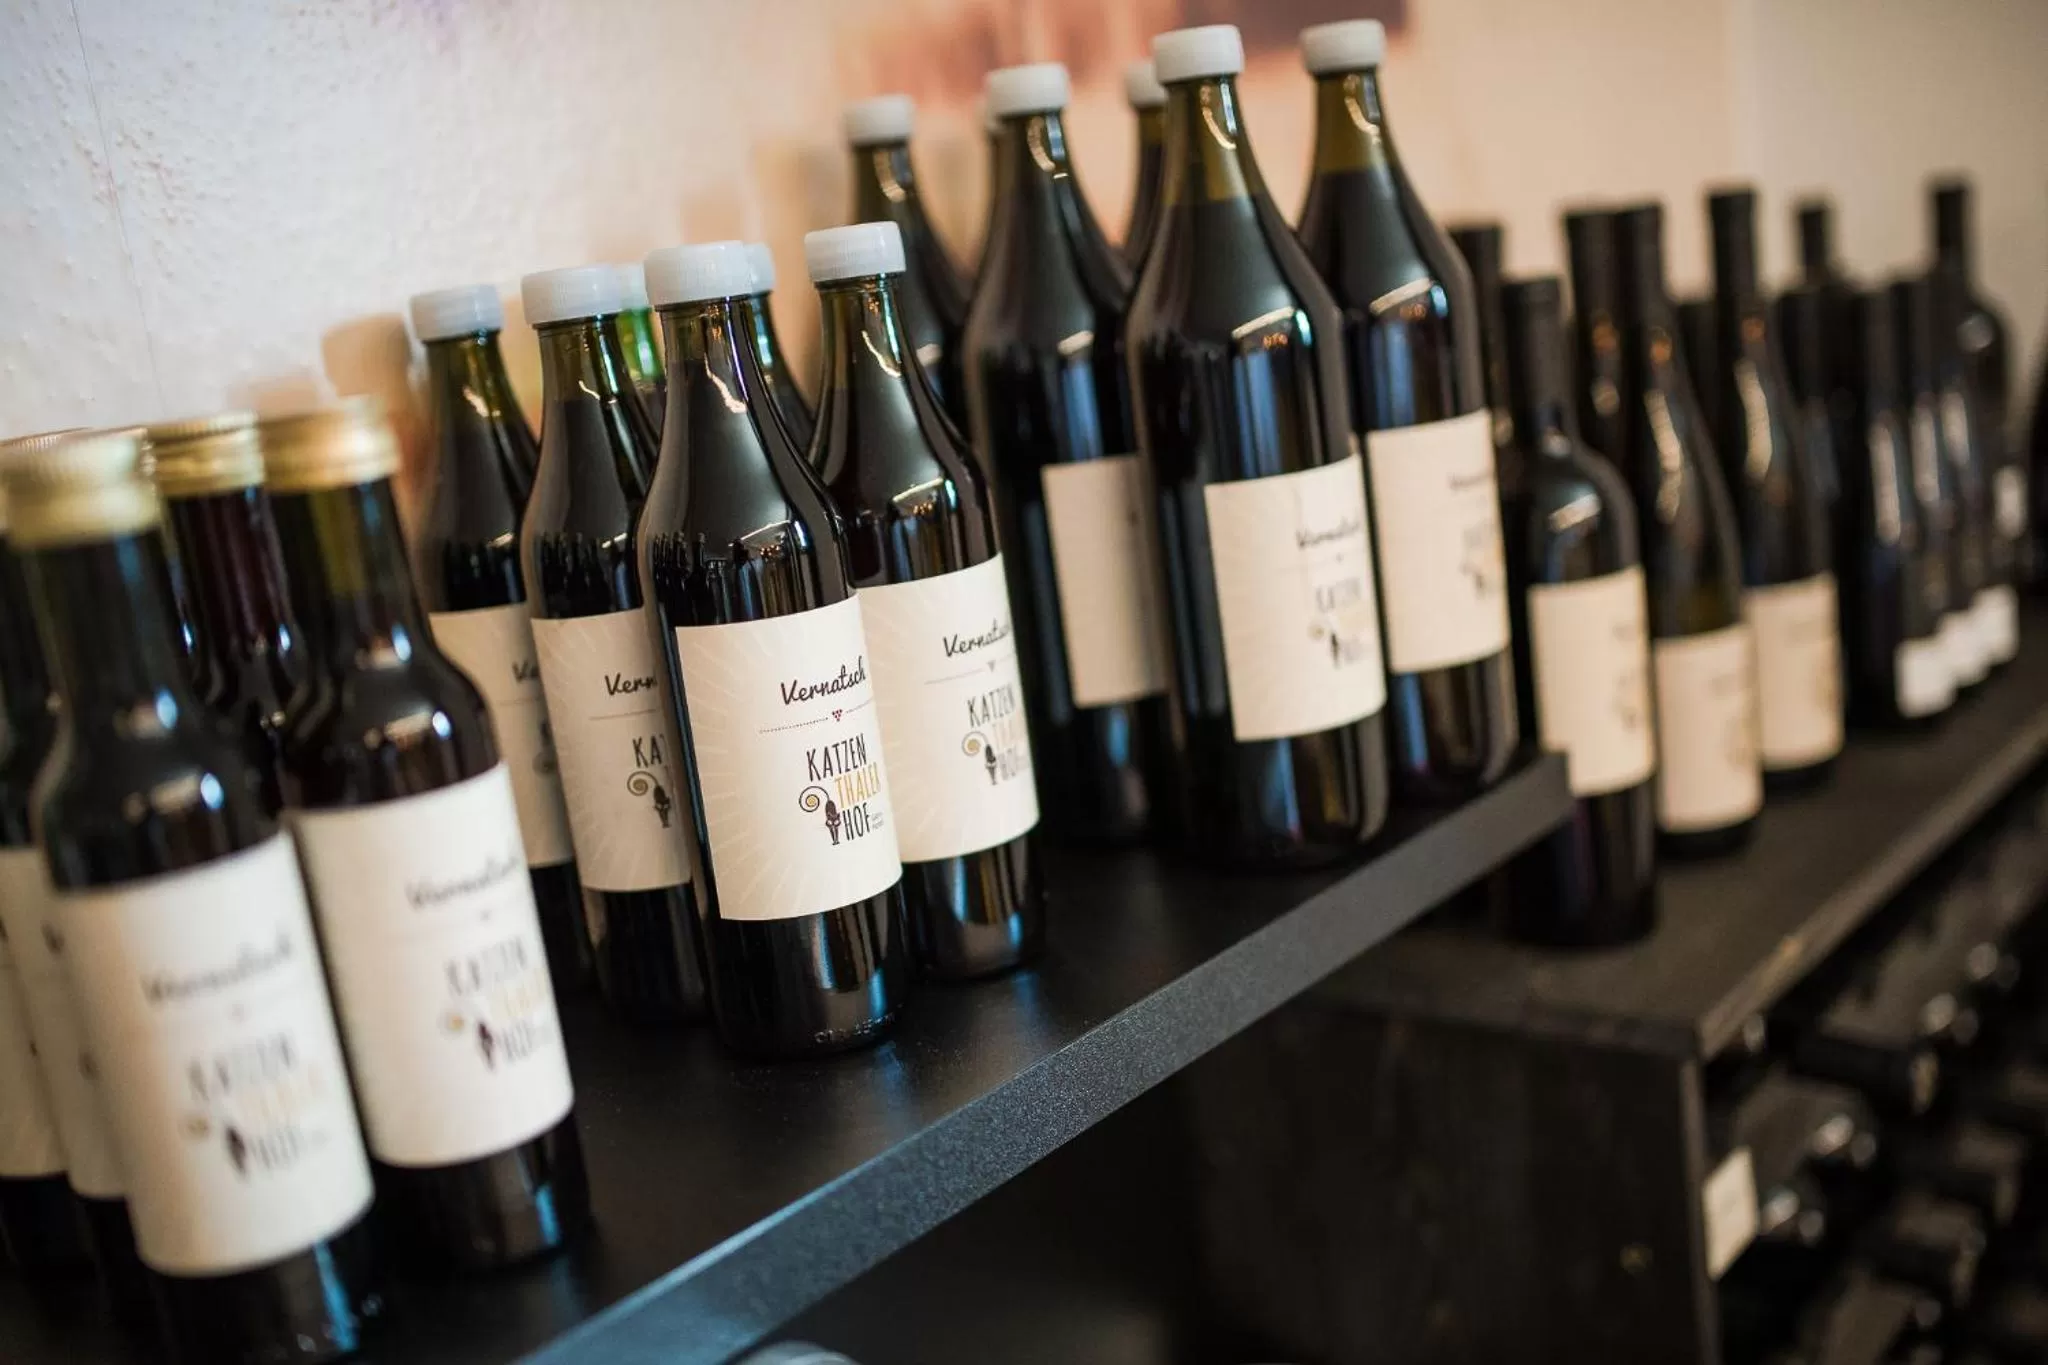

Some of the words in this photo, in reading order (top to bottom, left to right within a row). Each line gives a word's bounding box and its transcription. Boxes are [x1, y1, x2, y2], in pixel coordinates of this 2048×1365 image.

[780, 655, 866, 706] Vernatsch
[806, 732, 868, 783] KATZEN
[842, 802, 872, 841] HOF
